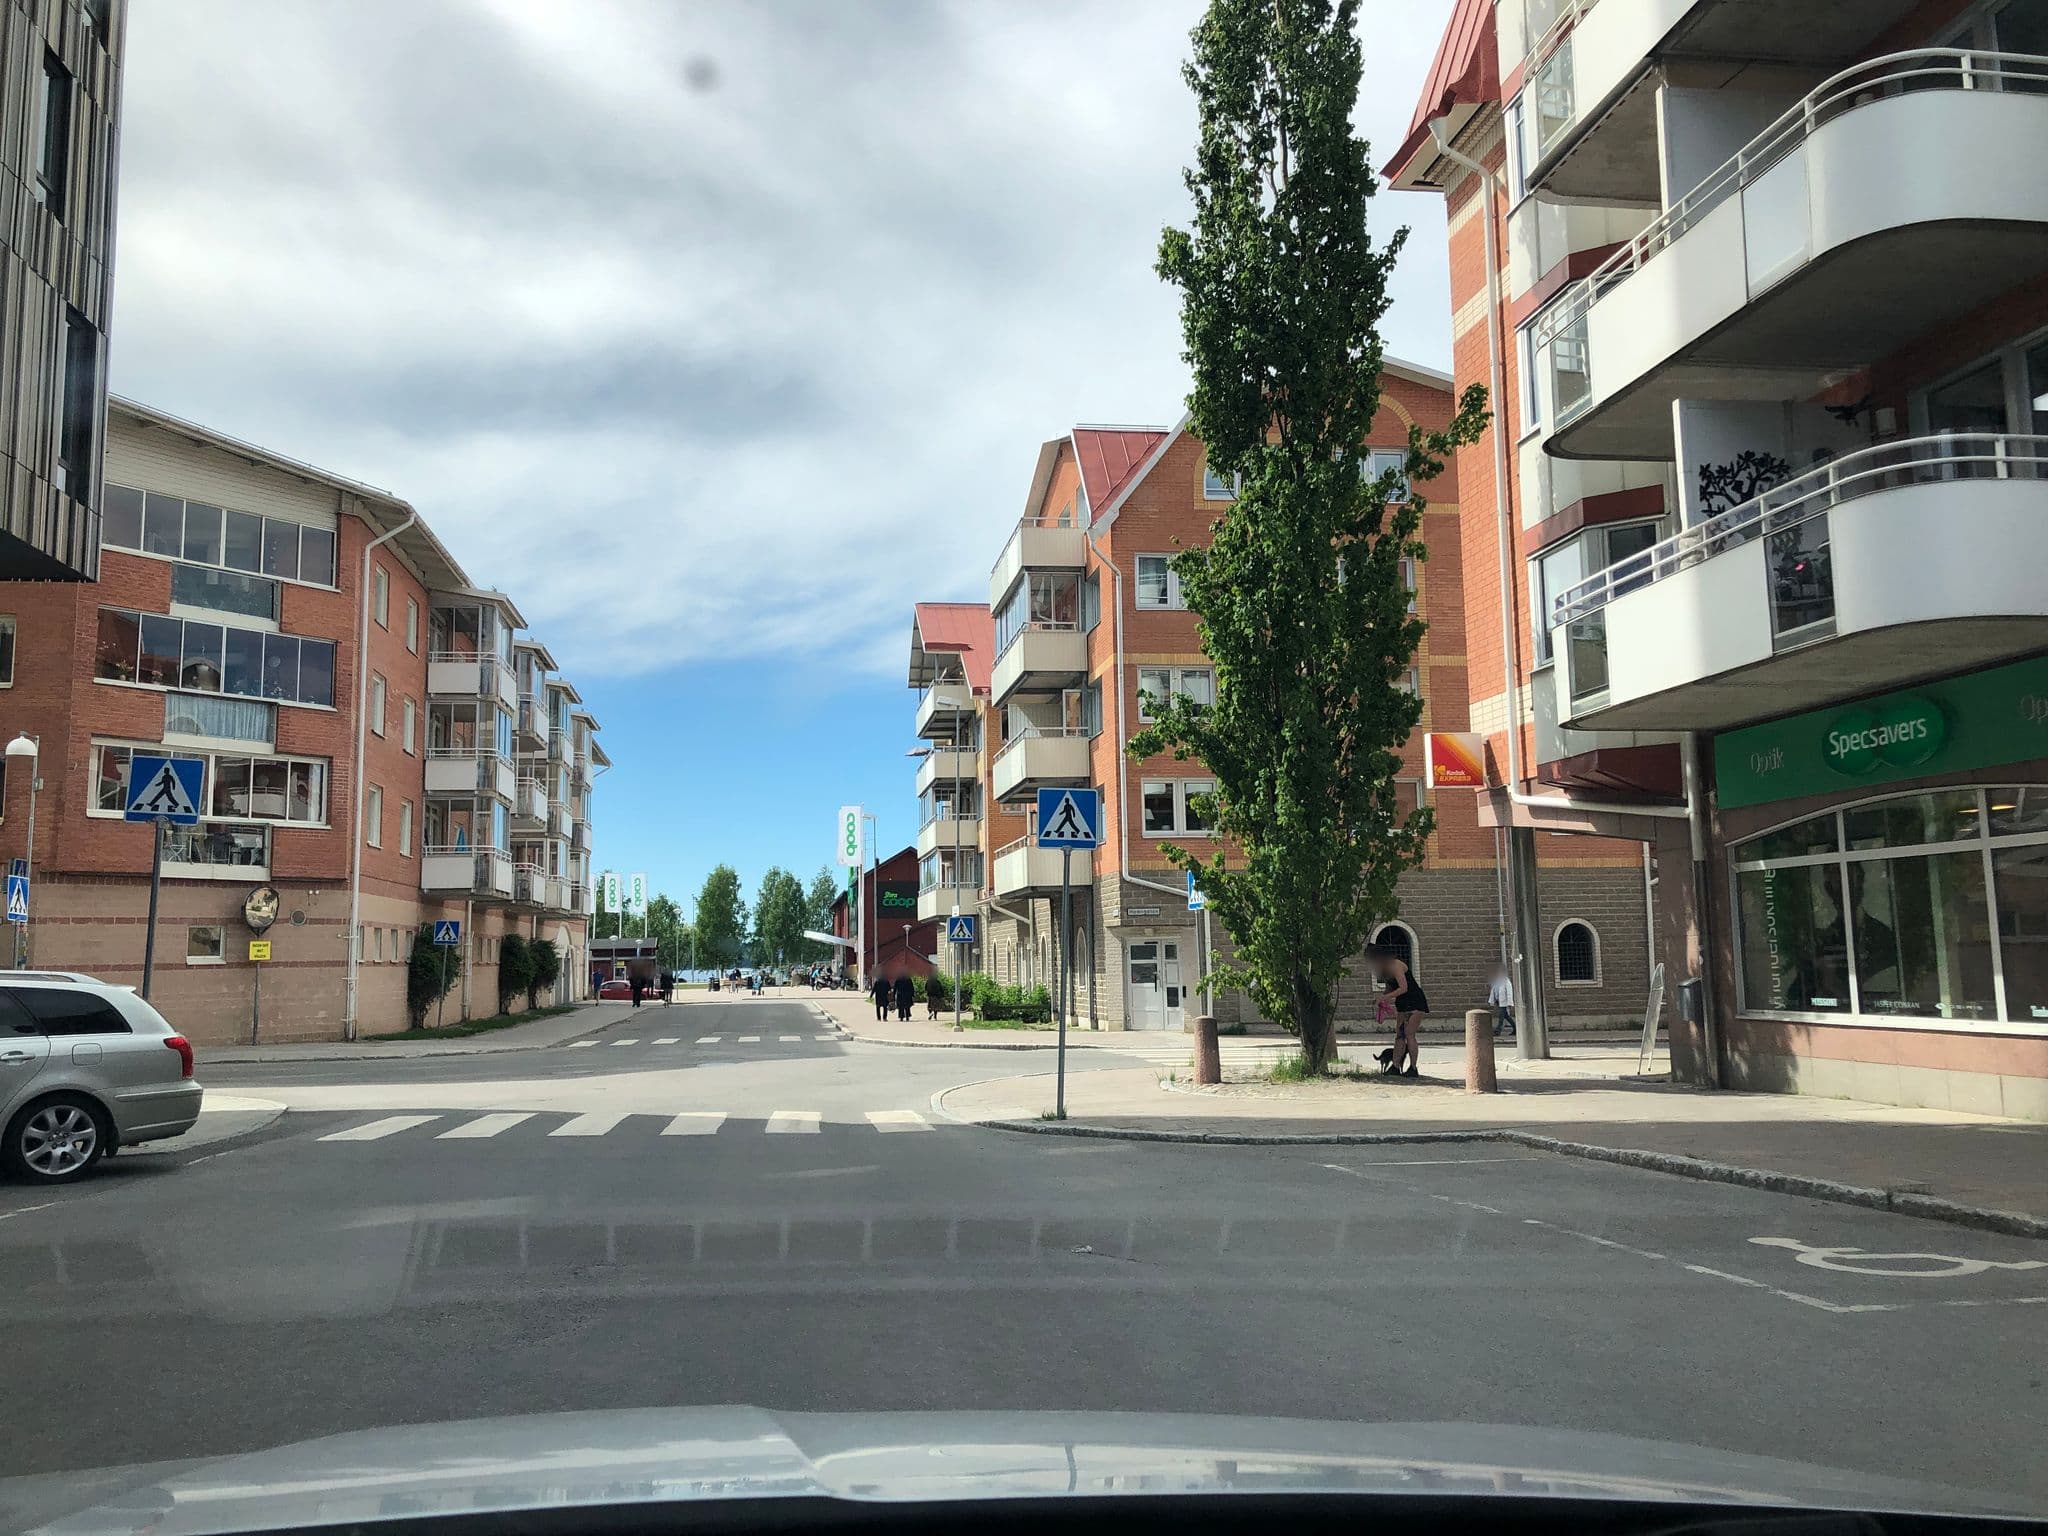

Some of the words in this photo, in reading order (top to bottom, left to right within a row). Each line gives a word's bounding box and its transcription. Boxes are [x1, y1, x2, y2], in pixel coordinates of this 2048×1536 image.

[1828, 718, 1928, 760] Specsavers
[1750, 746, 1785, 778] Optik
[846, 812, 858, 857] coop
[608, 878, 617, 908] coop
[633, 877, 643, 907] coop
